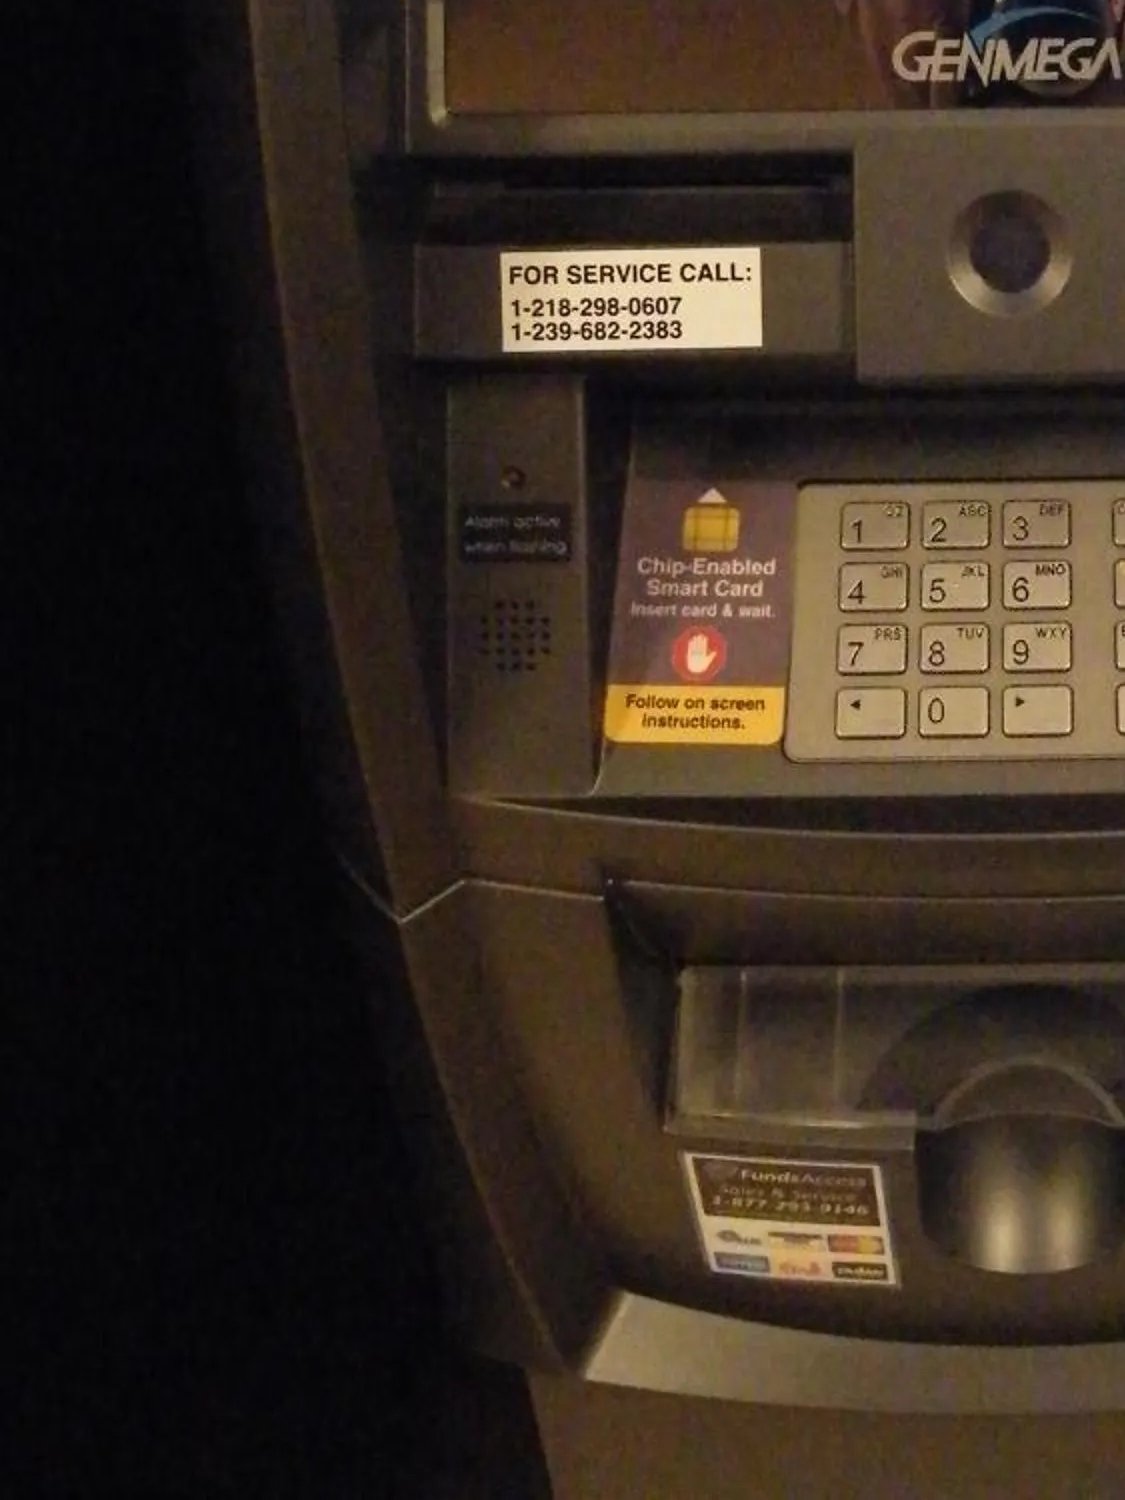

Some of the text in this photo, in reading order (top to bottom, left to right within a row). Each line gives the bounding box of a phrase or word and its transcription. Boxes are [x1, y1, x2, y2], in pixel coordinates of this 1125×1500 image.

[892, 31, 1122, 87] GENMEGA
[509, 263, 753, 284] FOR SERVICE CALL:
[511, 297, 682, 317] 1-218-298-0607
[511, 320, 683, 340] 1-239-682-2383
[958, 504, 987, 518] ABC
[851, 520, 863, 543] 1
[930, 518, 947, 542] 2
[1012, 516, 1029, 541] 3
[637, 556, 777, 578] Chip-Enabled
[1035, 564, 1067, 576] MNO
[646, 578, 764, 597] Smart Card
[847, 580, 865, 604] 4
[929, 578, 946, 603] 5
[1012, 577, 1029, 602] 6
[631, 602, 776, 618] Insert card & wait.
[874, 627, 902, 641] PRS
[956, 627, 985, 639] TUV
[1035, 627, 1067, 639] WXY
[847, 641, 864, 666] 7
[928, 641, 945, 666] 8
[1013, 639, 1029, 665] 9
[624, 694, 766, 711] Follow on screen
[927, 698, 945, 723] 0
[641, 714, 746, 731] instructions.
